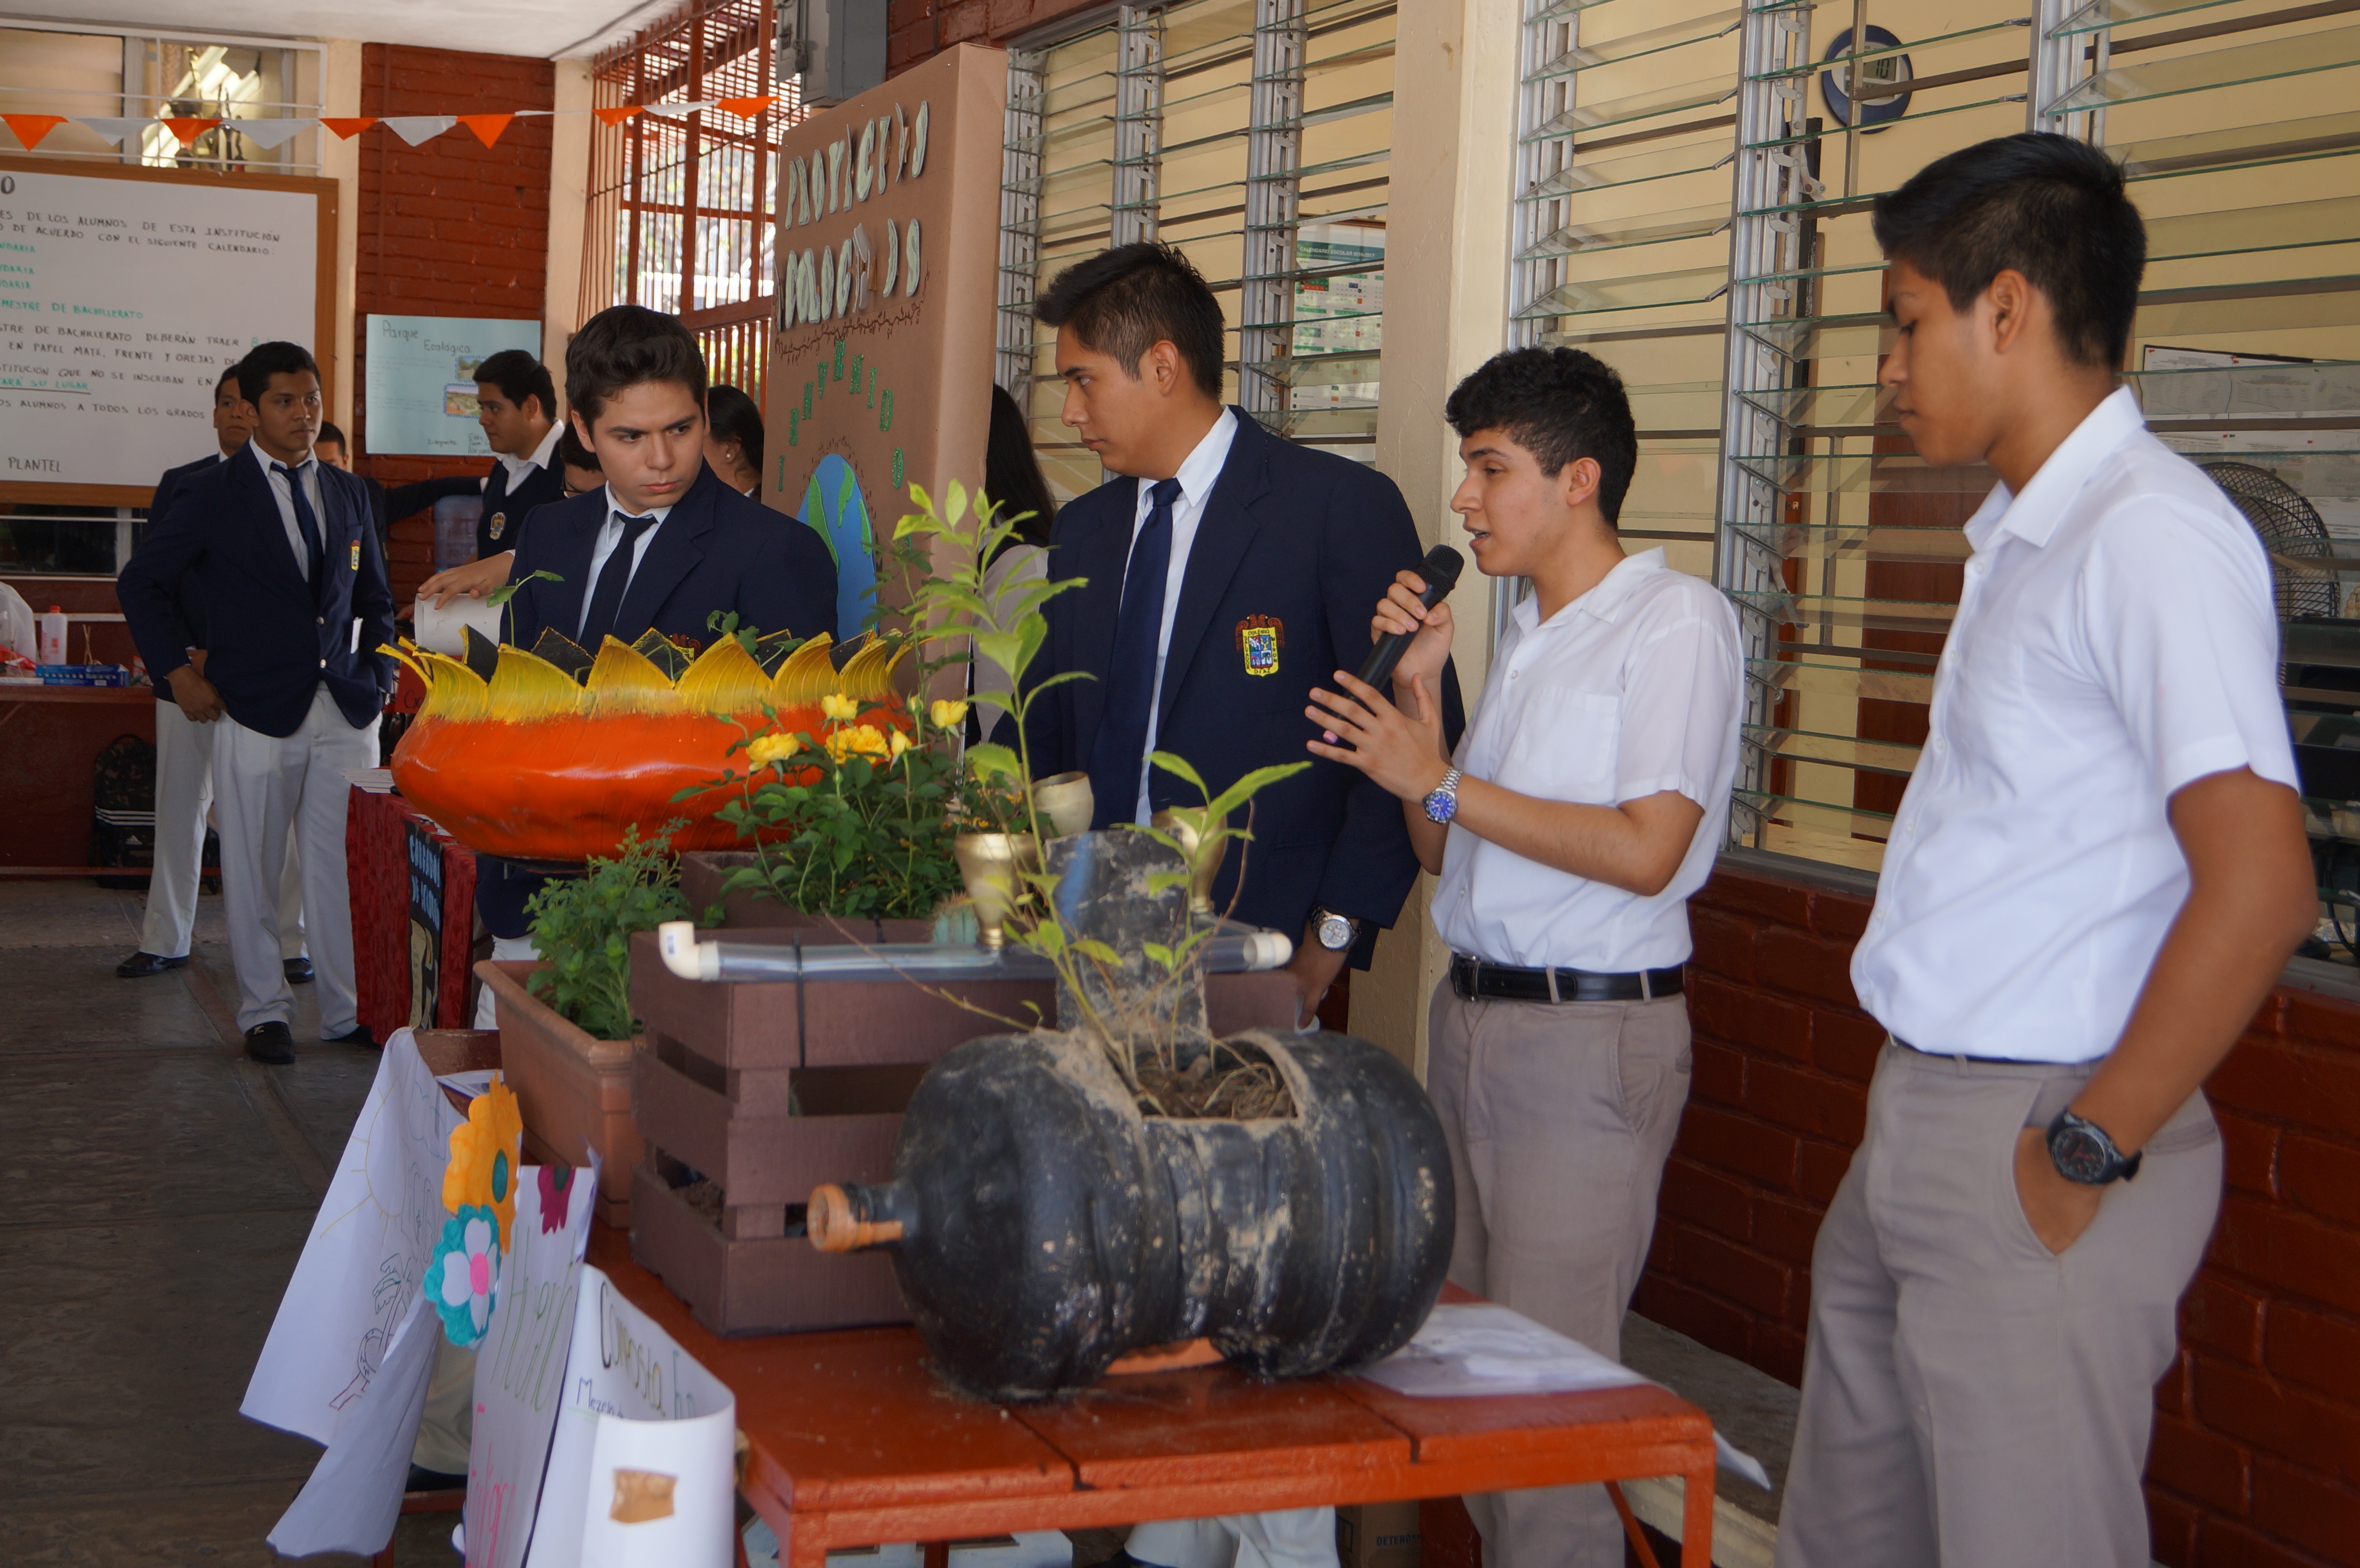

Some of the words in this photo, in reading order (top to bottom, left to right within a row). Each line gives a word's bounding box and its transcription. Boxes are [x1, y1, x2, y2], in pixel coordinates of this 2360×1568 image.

[27, 212, 42, 221] DE
[48, 214, 69, 223] LOS
[77, 216, 127, 228] ALUMNOS
[143, 221, 157, 231] DE
[170, 224, 196, 234] ESTA
[13, 224, 26, 233] DE
[36, 226, 84, 239] ACUERDO
[128, 236, 140, 244] EL
[147, 238, 197, 249] SIGUIENTE
[51, 302, 66, 313] DE
[73, 305, 143, 319] BACHILLERATO
[35, 325, 50, 334] DE
[58, 327, 132, 341] BACHILLERATO
[207, 336, 239, 346] TRAER
[382, 319, 418, 342] Parque
[9, 341, 24, 351] EN
[33, 342, 64, 354] PAPEL
[115, 349, 153, 360] FRENTE
[165, 353, 170, 362] Y
[176, 354, 215, 364] OREJAS
[58, 368, 82, 377] QUE
[111, 372, 124, 380] SE
[133, 373, 184, 385] INSCRIBAN
[20, 400, 66, 410] ALUMNOS
[77, 403, 85, 411] A
[93, 404, 129, 413] TODOS
[166, 408, 205, 419] GRADOS
[9, 457, 61, 472] PLANTEL
